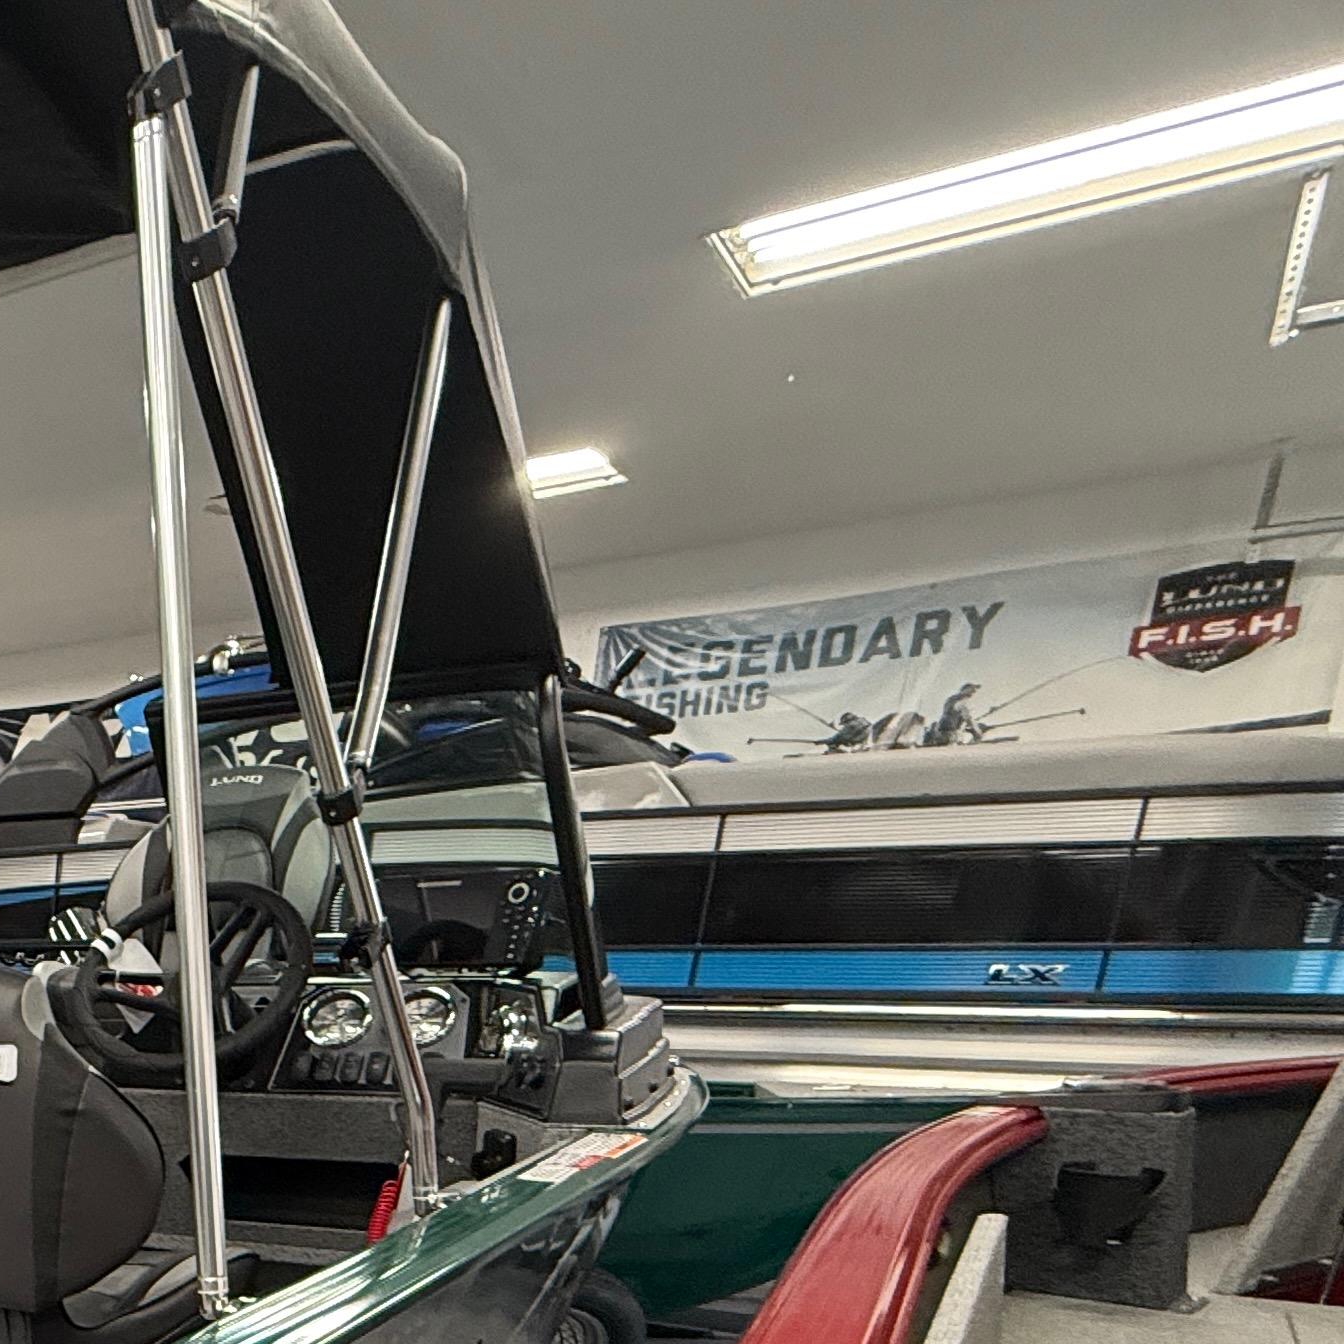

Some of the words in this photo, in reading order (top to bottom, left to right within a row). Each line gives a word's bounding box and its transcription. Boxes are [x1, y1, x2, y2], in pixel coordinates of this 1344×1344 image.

[1138, 612, 1293, 649] F.I.S.H.
[209, 774, 264, 787] LUND
[985, 963, 1071, 986] LX
